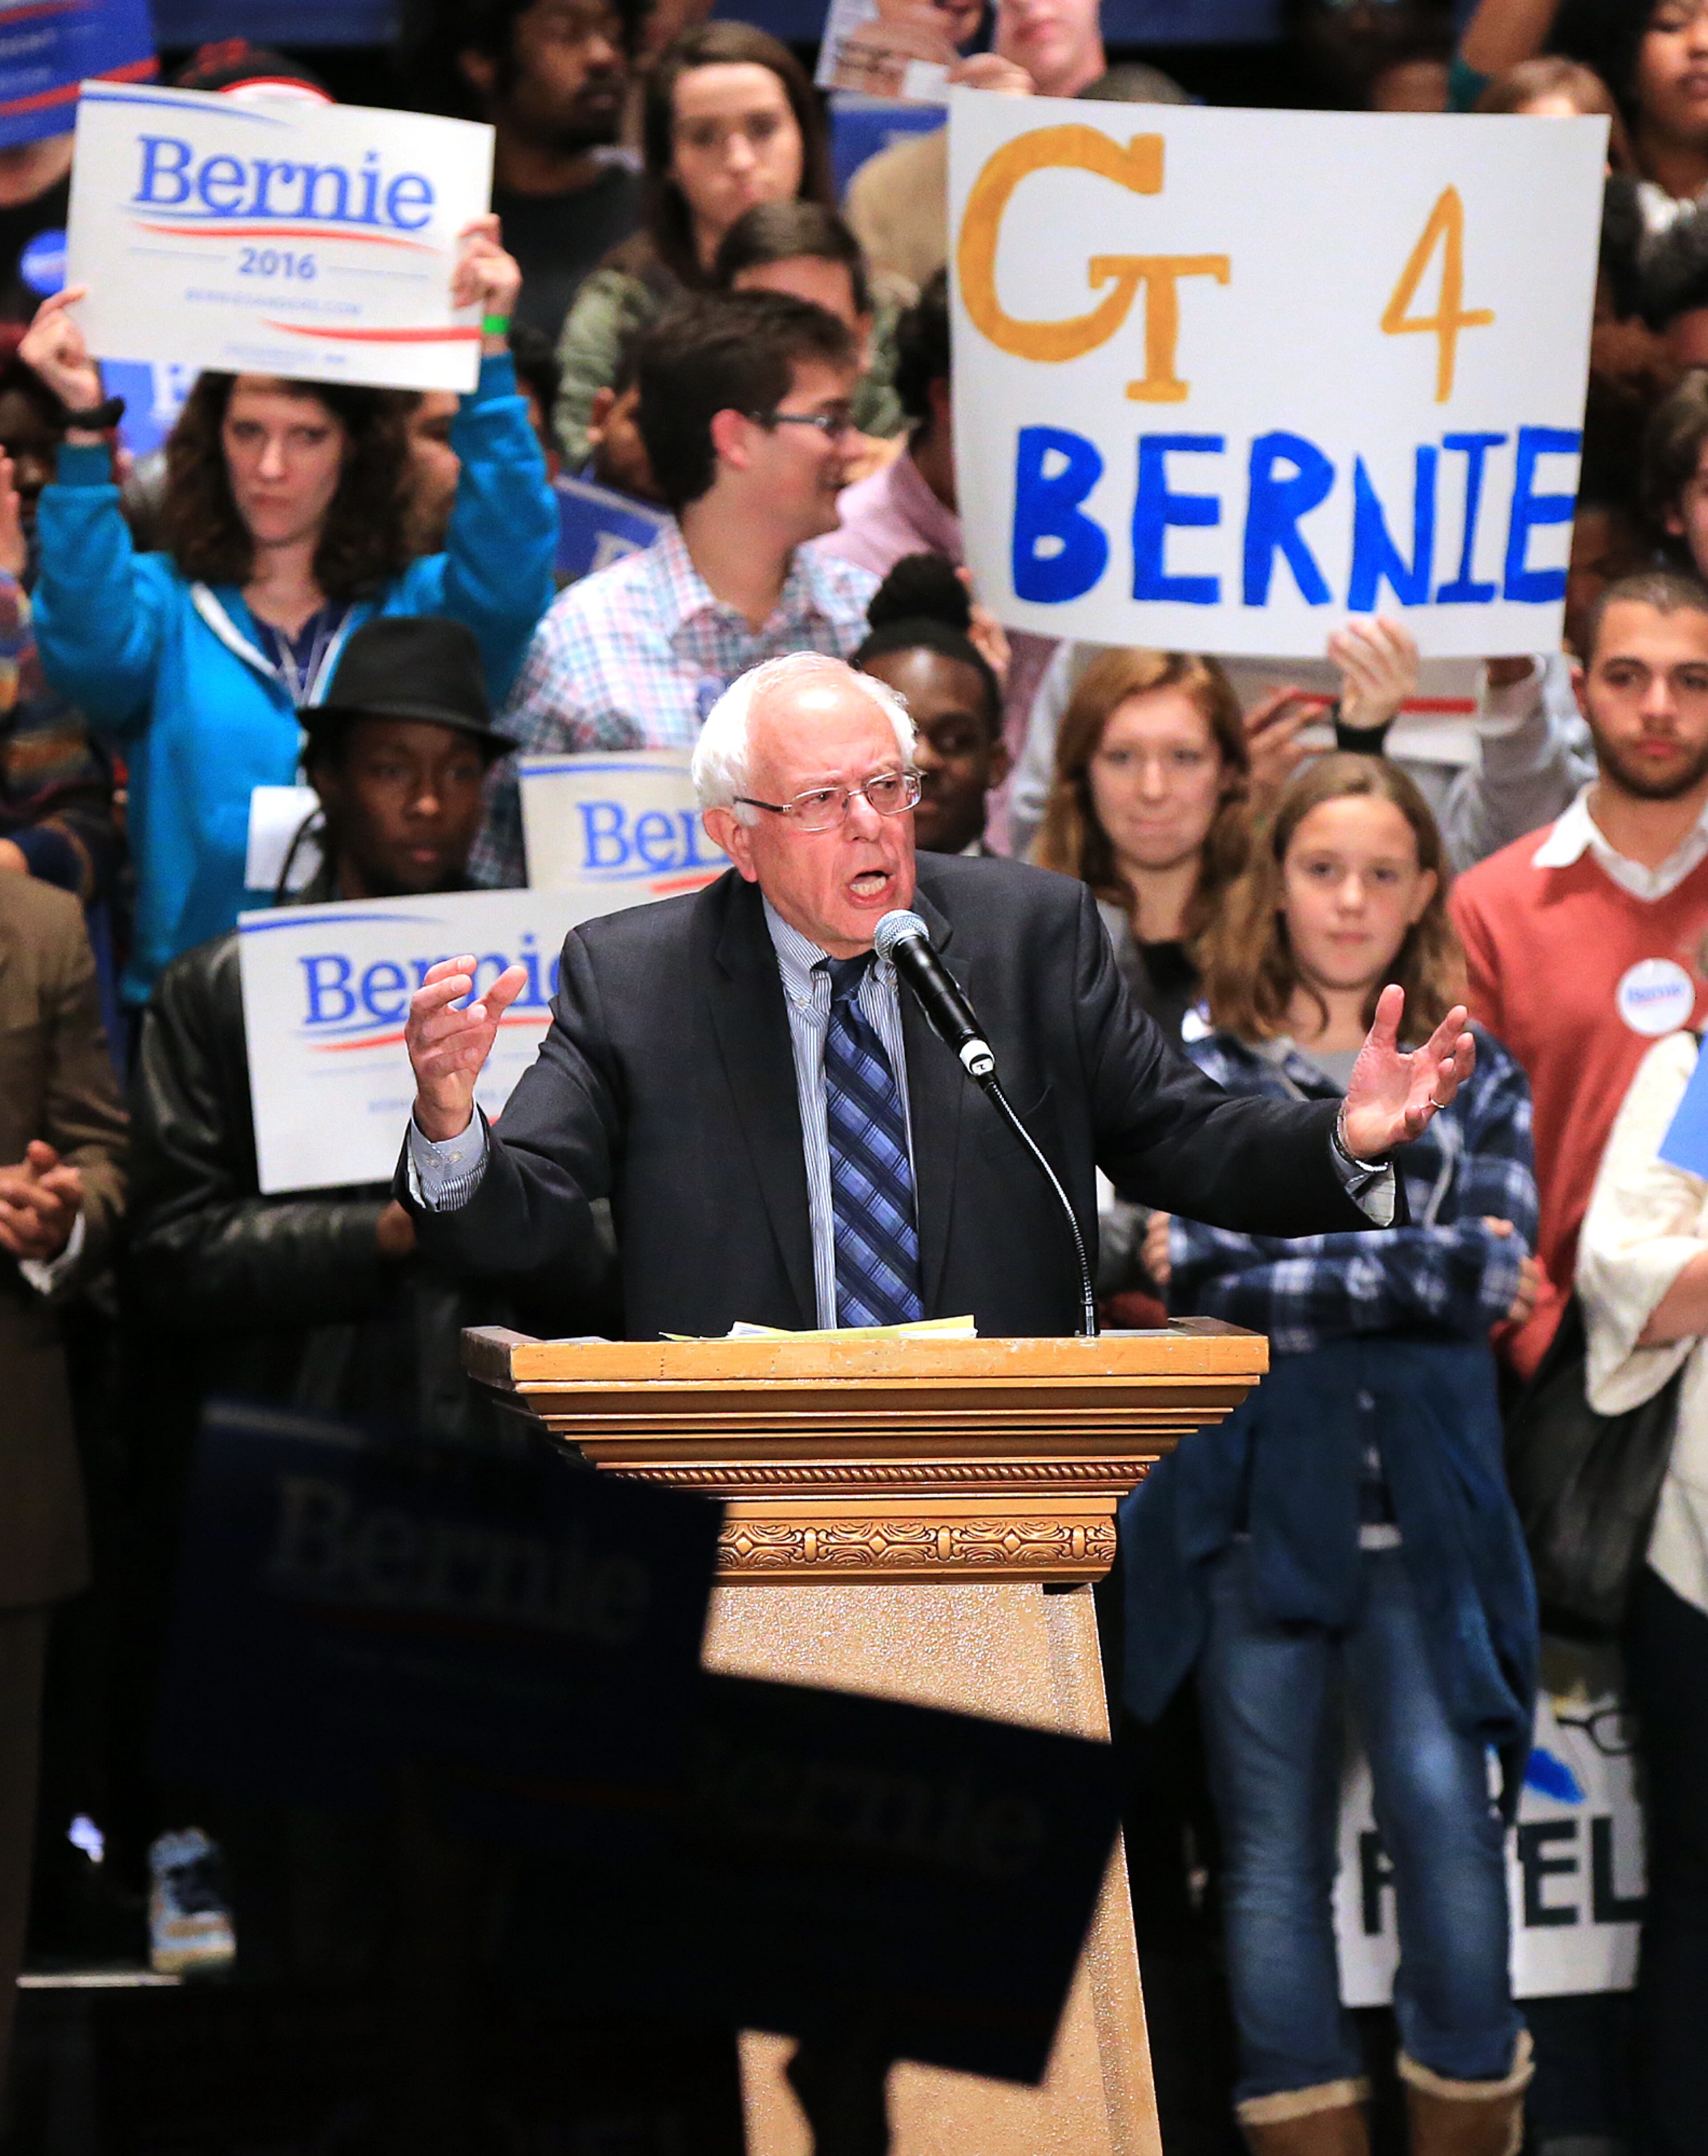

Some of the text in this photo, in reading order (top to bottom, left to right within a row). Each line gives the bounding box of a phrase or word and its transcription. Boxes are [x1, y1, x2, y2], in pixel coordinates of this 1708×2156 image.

[133, 133, 436, 231] Bernie
[238, 246, 318, 281] 2016
[957, 124, 1495, 403] GT 4
[1011, 424, 1583, 611] BERNIE
[576, 800, 730, 873] Ber
[263, 1473, 652, 1649] Bernie
